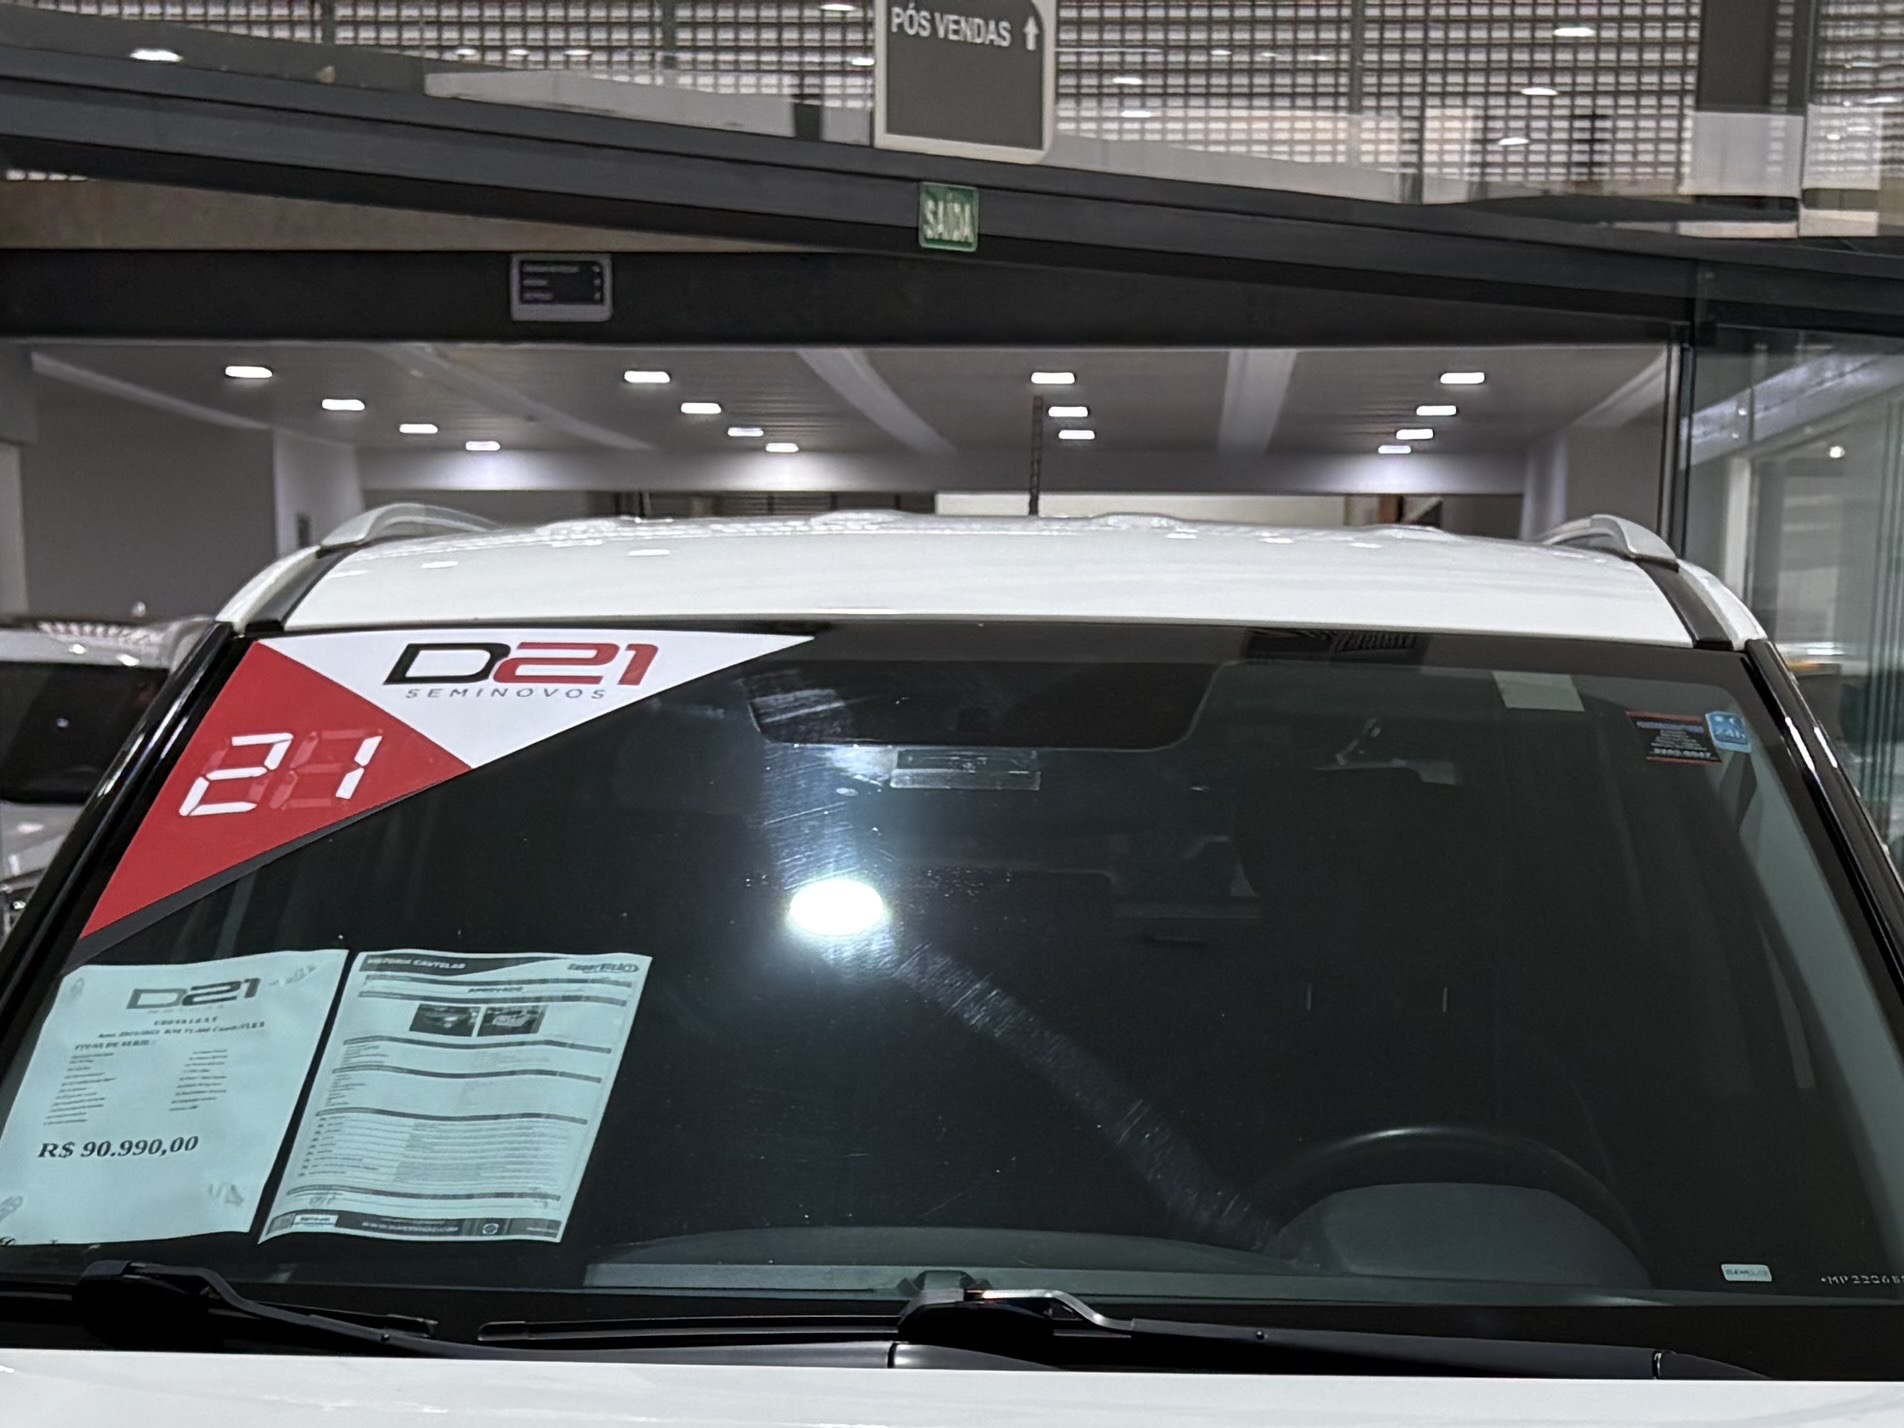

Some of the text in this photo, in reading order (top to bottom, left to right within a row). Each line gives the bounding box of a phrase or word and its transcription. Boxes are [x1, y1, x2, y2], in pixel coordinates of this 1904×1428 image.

[891, 1, 1012, 47] PÓS VENDAS
[382, 641, 658, 685] D21
[405, 687, 608, 700] SEMINOVOS
[126, 977, 261, 1010] D21
[38, 1135, 200, 1159] R$ 90.990,00
